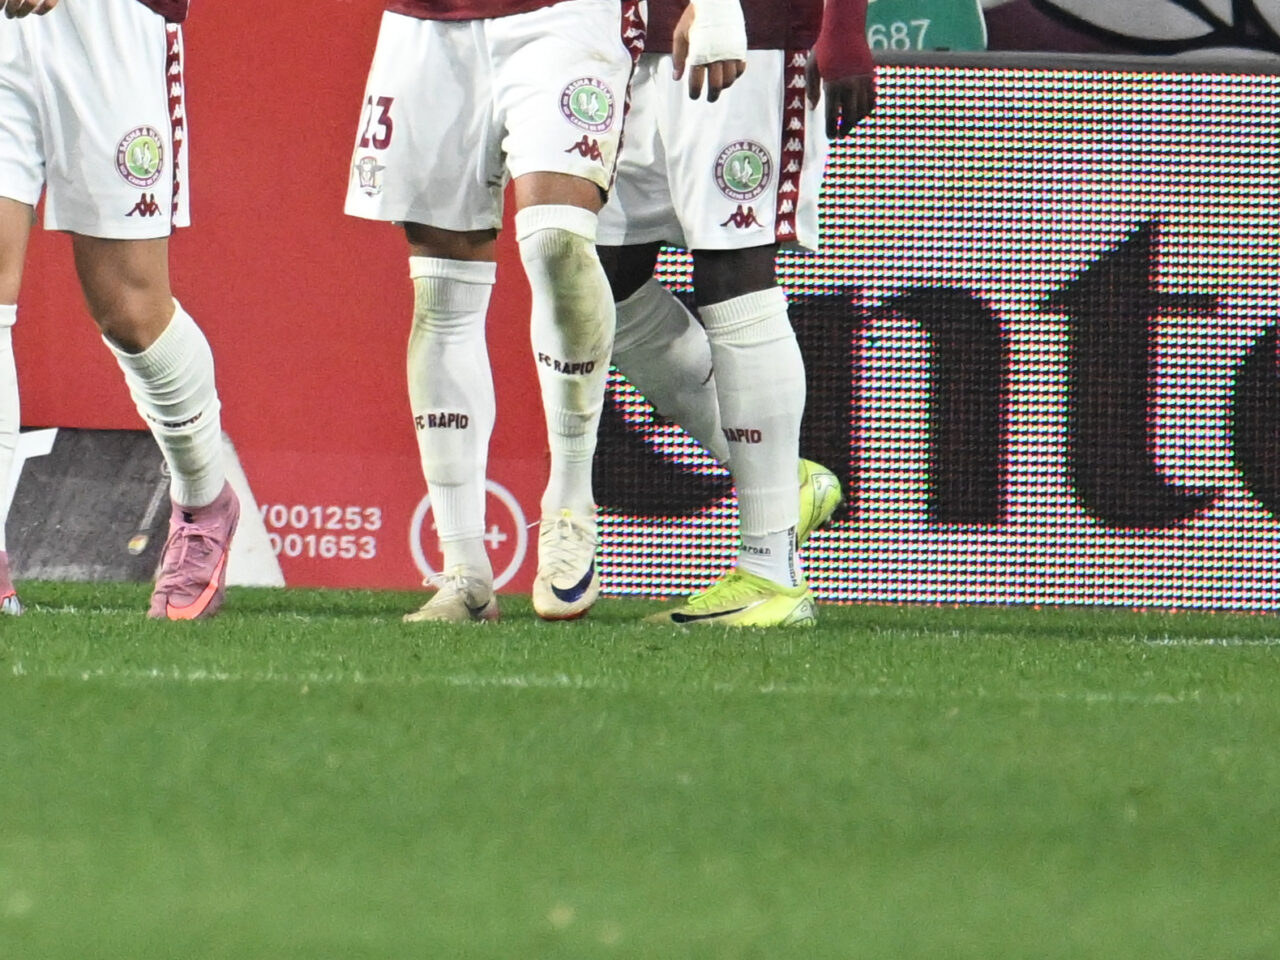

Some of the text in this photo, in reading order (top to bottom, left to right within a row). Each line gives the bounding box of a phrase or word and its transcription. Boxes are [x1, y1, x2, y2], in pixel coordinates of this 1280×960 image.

[553, 360, 595, 375] RAPID
[428, 412, 469, 429] RAPID
[261, 504, 382, 531] 001253
